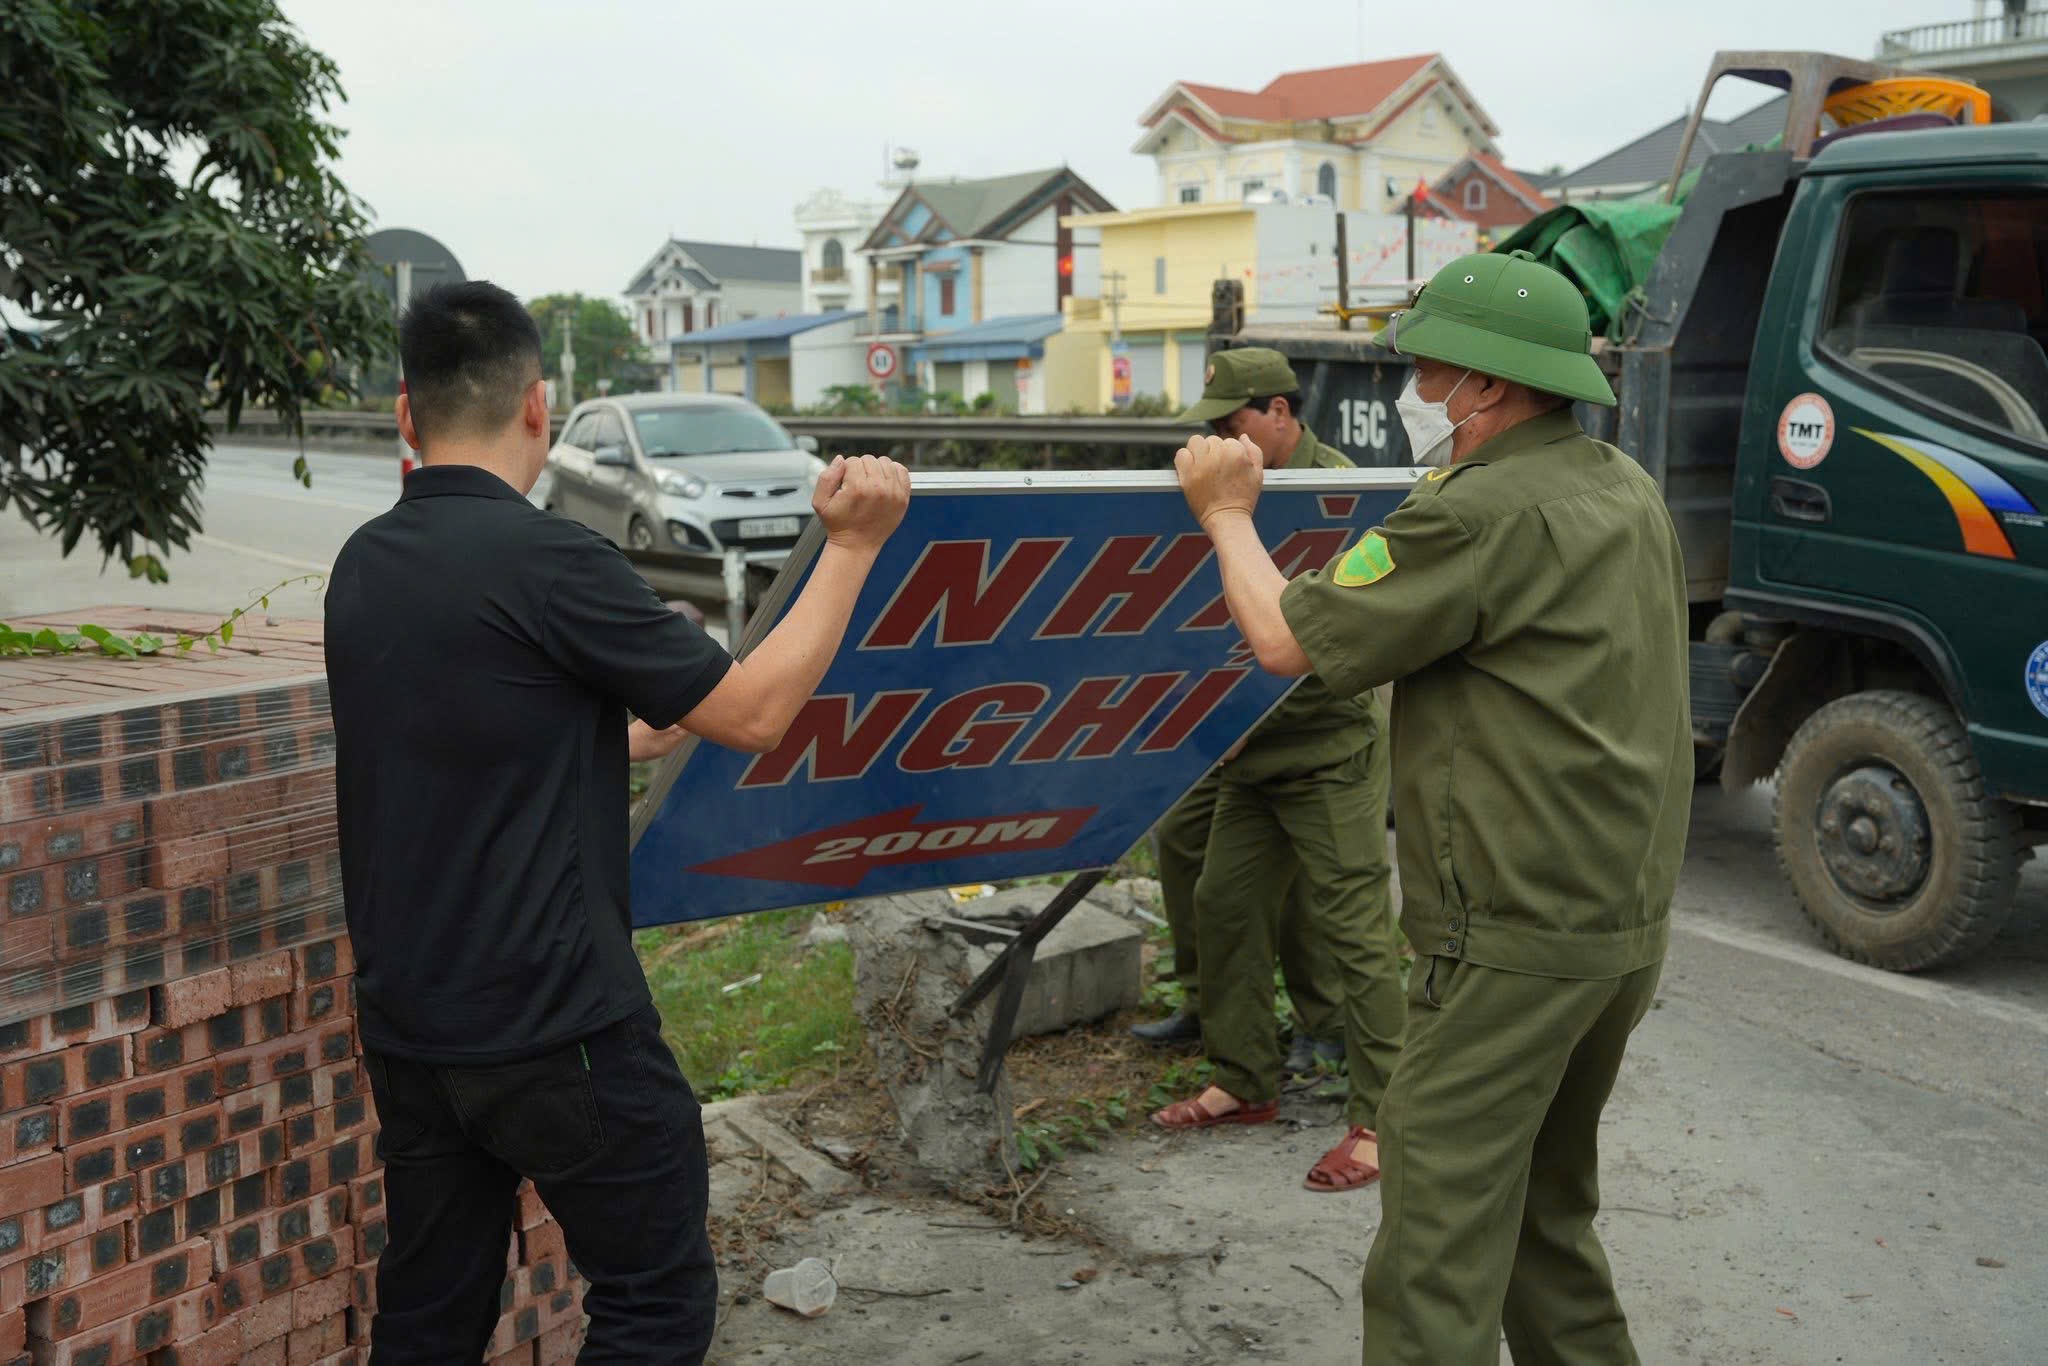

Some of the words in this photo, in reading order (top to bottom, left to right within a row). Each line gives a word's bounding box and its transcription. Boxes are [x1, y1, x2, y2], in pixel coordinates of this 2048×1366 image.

[1338, 398, 1387, 450] 15C
[1788, 422, 1825, 440] TMT
[802, 817, 1061, 866] 200M
